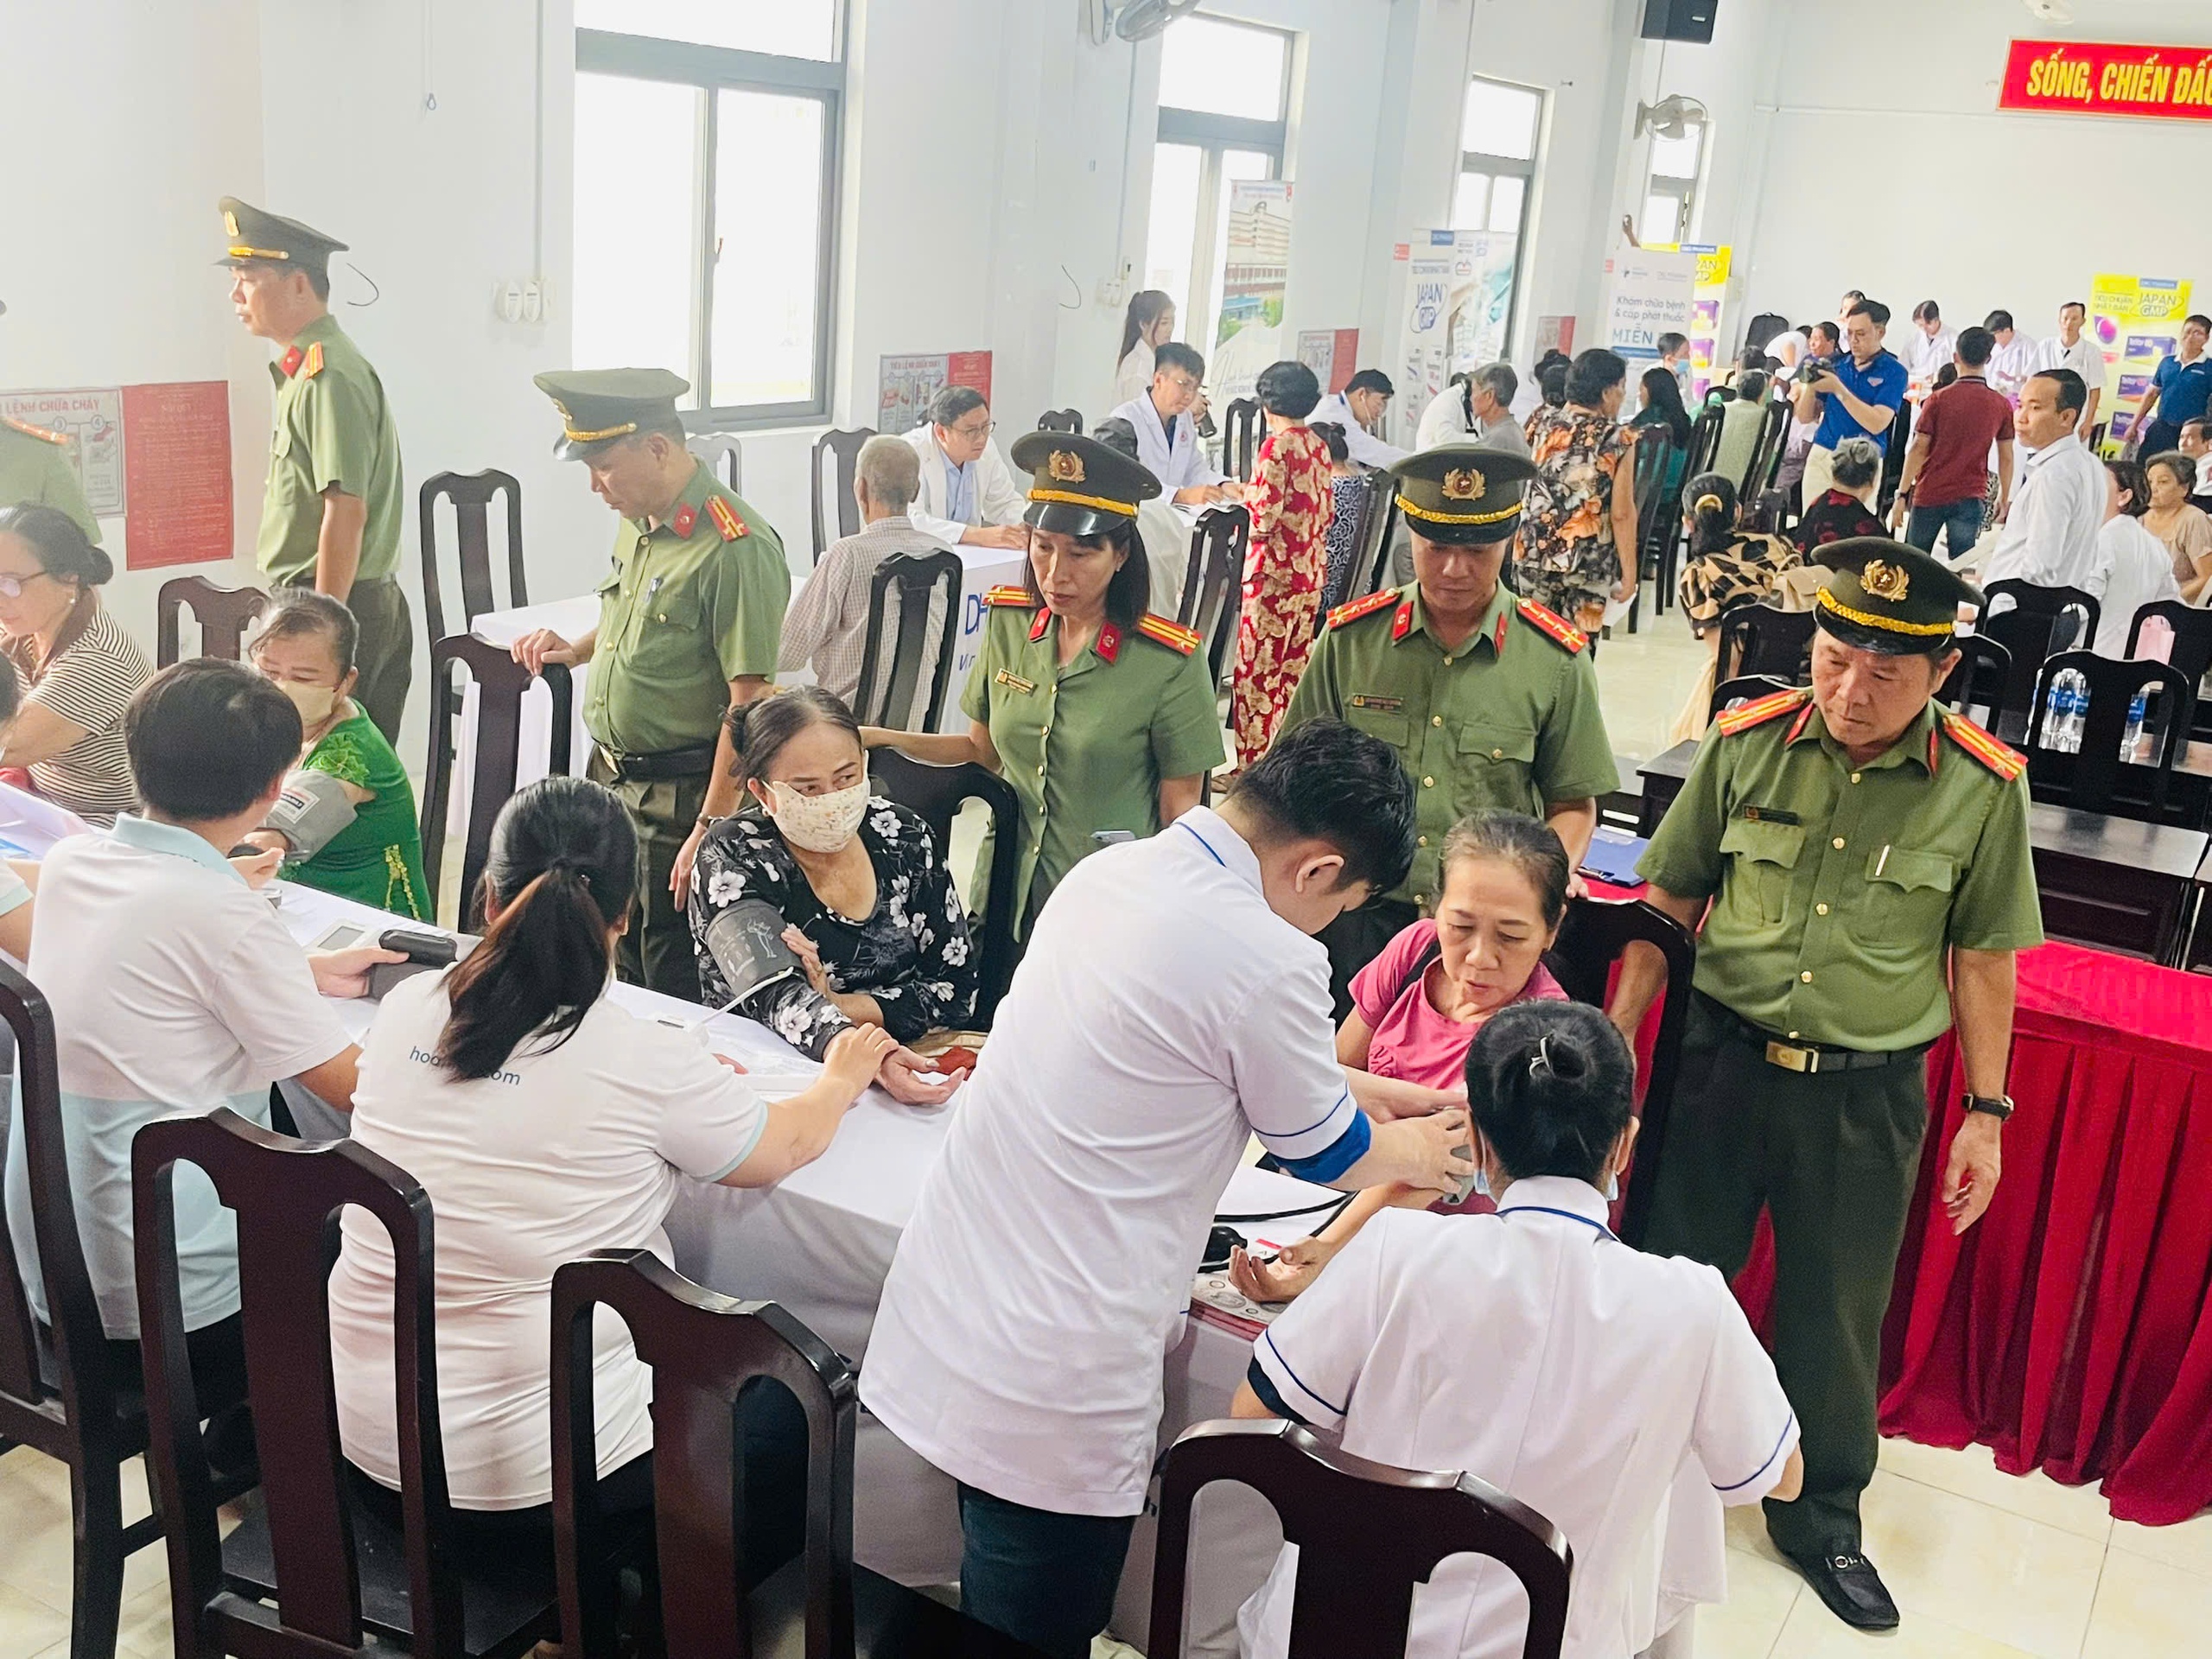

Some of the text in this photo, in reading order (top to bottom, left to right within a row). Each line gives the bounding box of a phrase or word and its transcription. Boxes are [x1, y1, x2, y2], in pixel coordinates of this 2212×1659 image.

[2026, 48, 2094, 104] SỐNG,
[2100, 53, 2171, 103] CHIẾN
[2138, 292, 2177, 306] JAPAN
